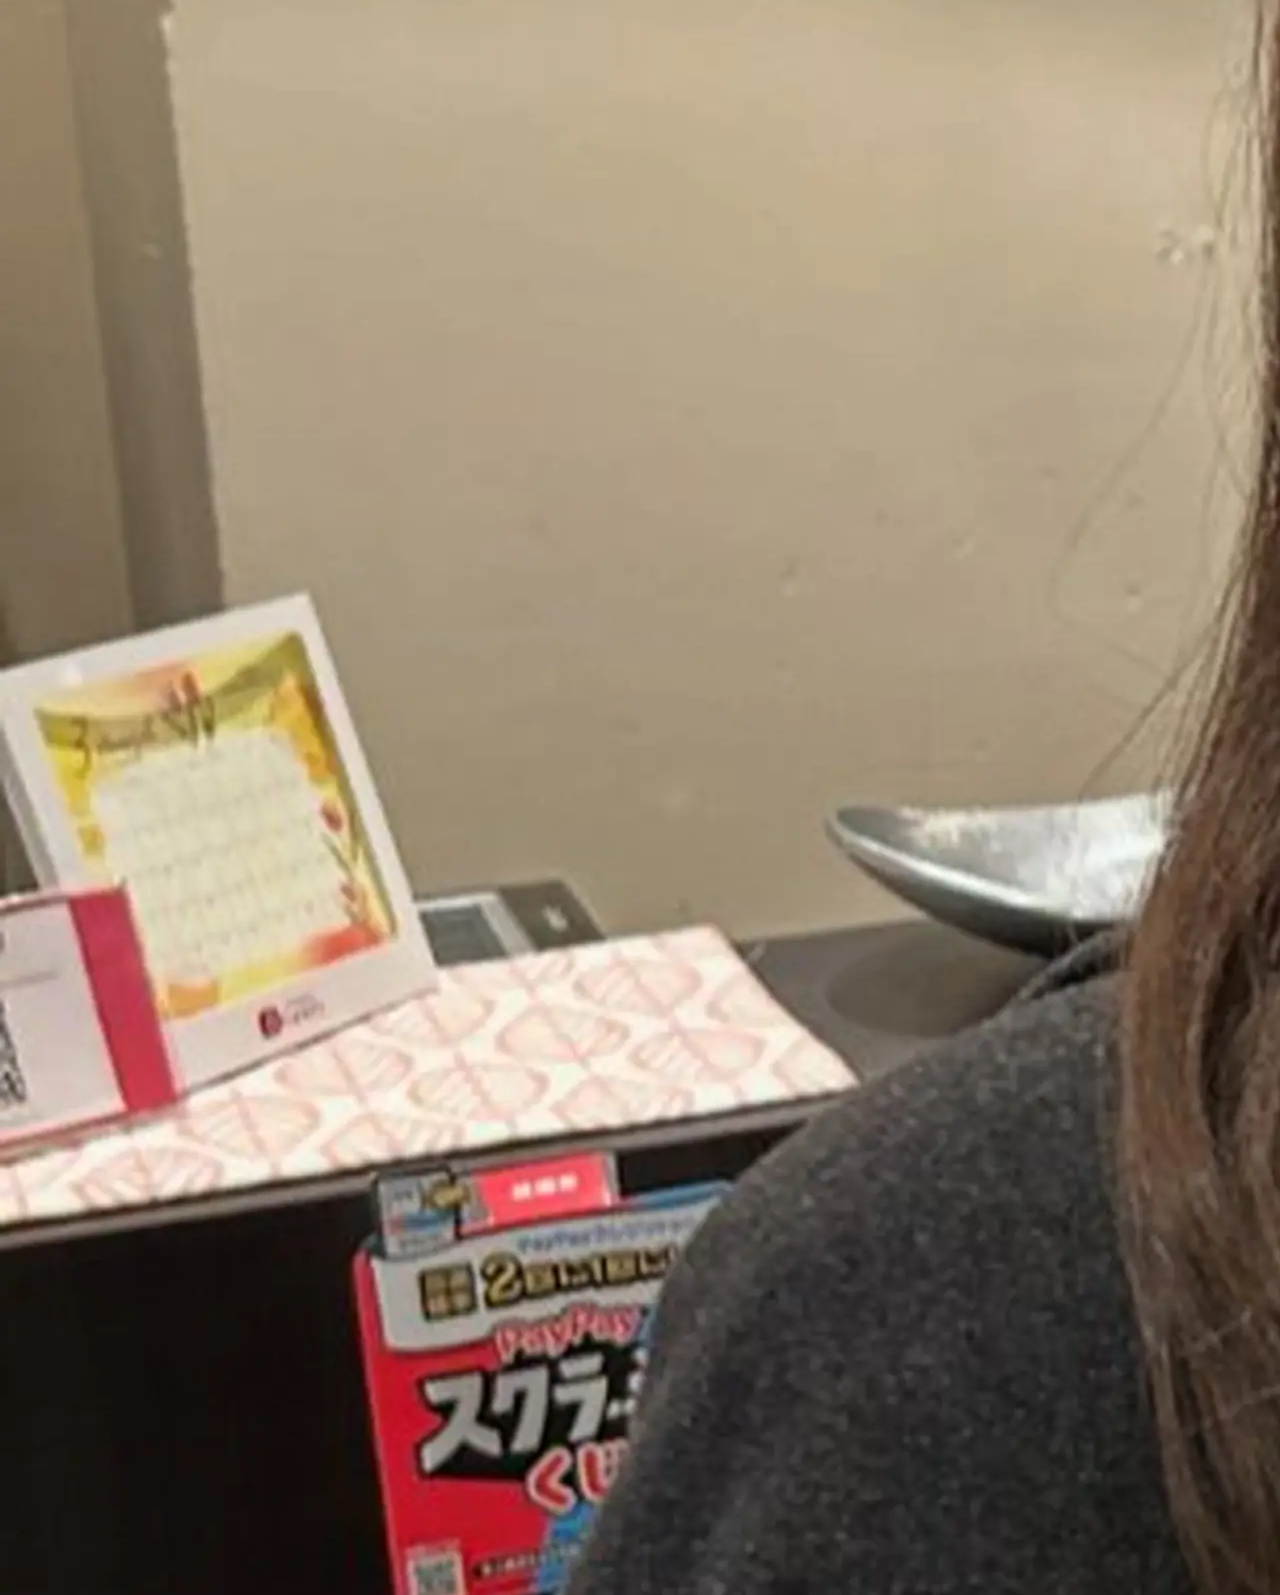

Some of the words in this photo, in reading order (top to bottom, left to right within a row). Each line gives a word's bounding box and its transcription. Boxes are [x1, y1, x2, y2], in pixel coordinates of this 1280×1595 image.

[497, 1304, 641, 1364] PayPay
[421, 1347, 647, 1474] スクラ
